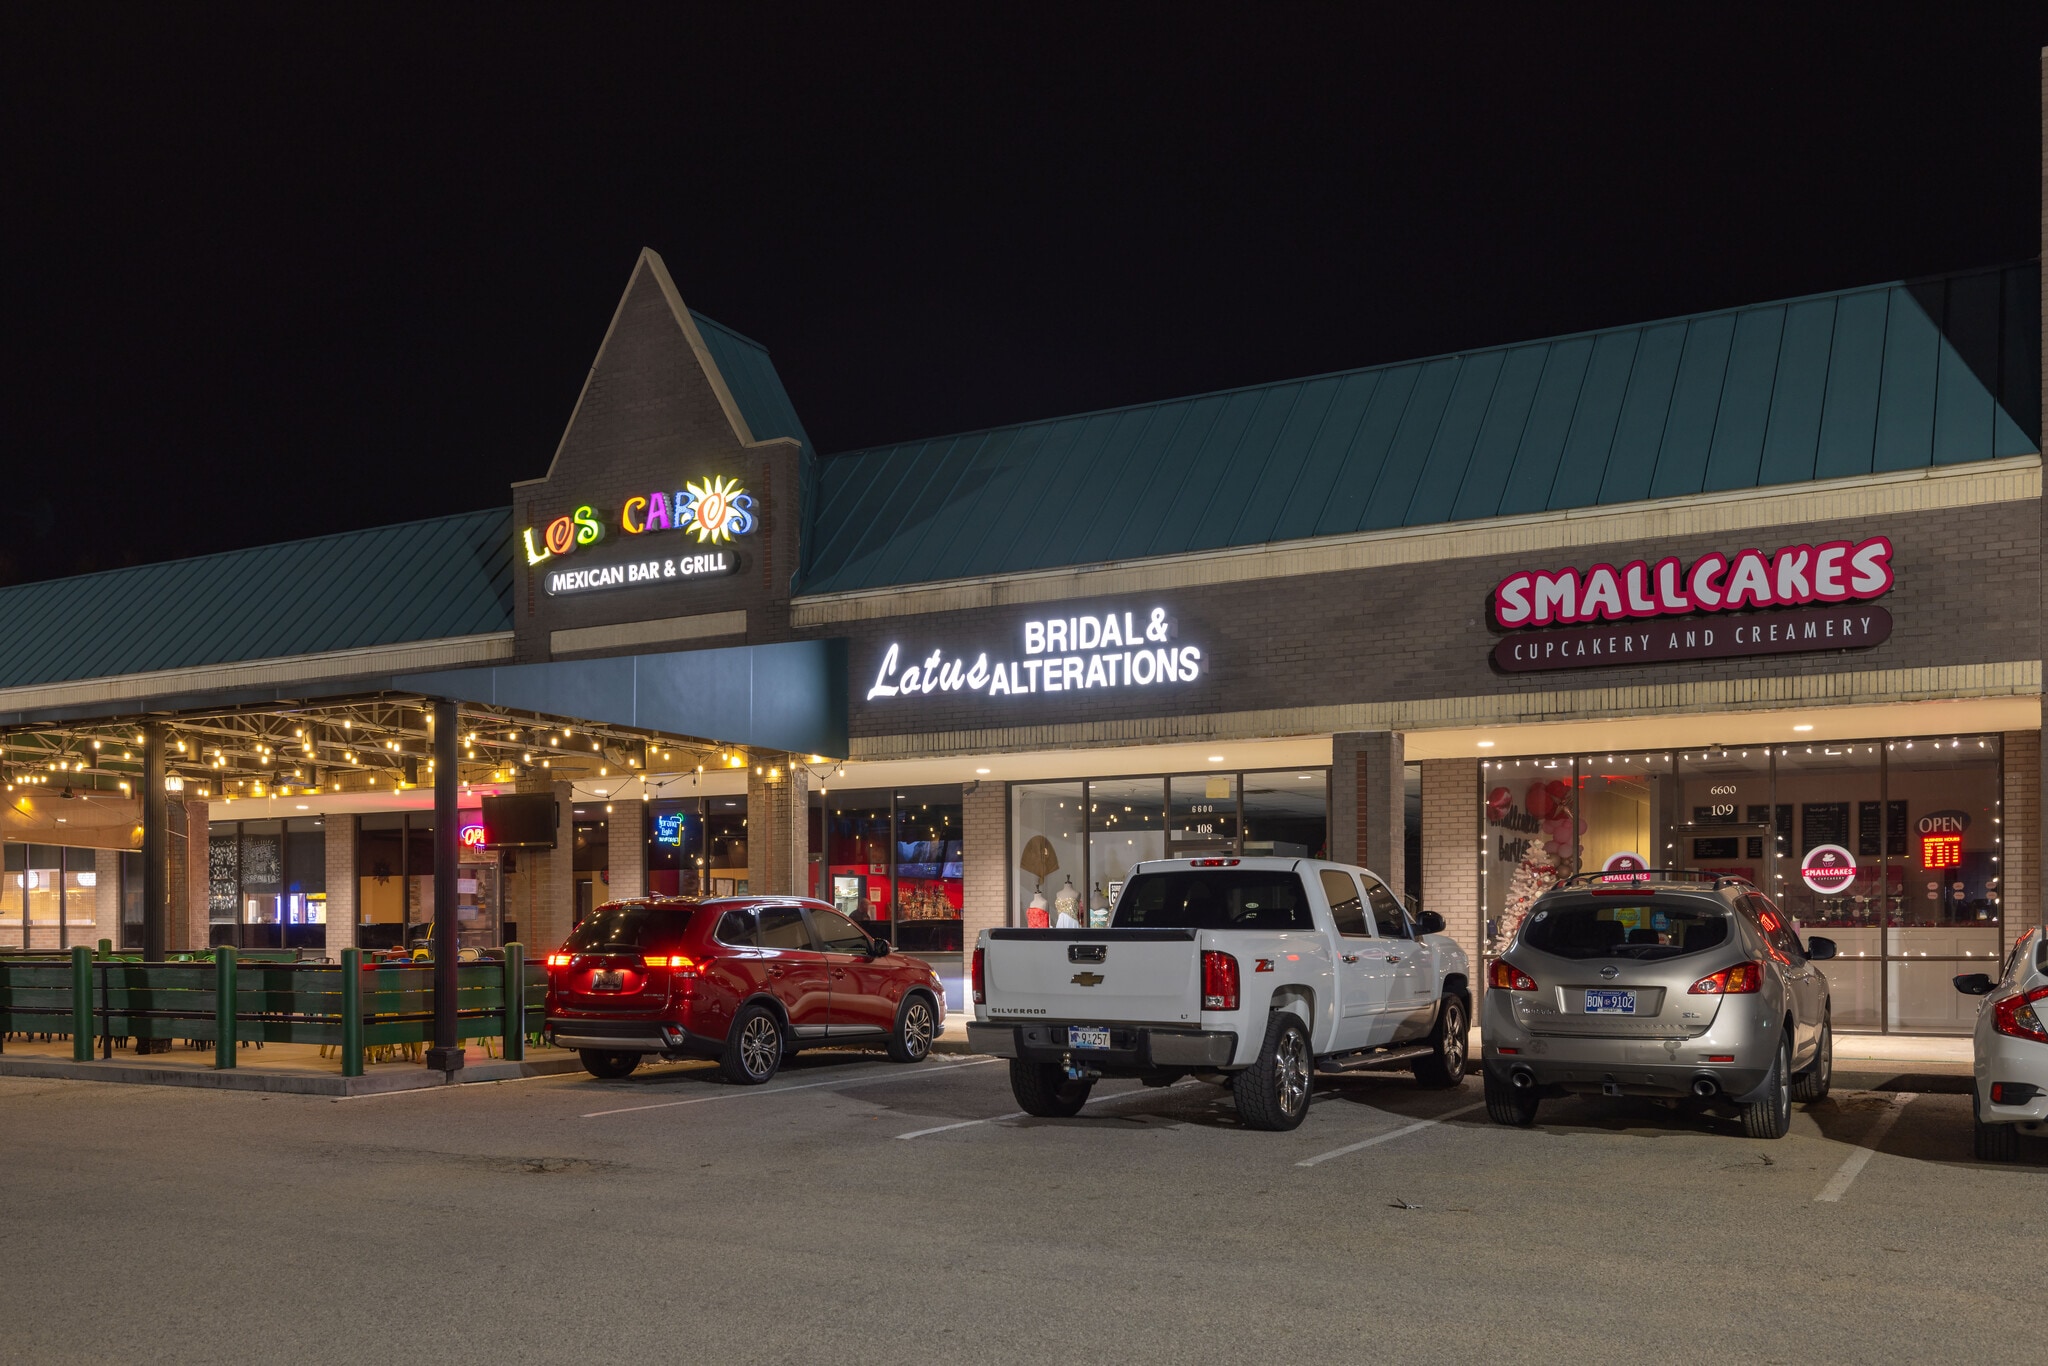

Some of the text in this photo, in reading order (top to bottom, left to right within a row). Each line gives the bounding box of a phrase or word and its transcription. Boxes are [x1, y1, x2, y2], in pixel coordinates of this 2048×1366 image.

[523, 490, 754, 566] LOS CABOS
[551, 552, 727, 592] MEXICAN BAR & GRILL
[1500, 541, 1888, 624] SMALLCAKES
[1025, 606, 1169, 655] BRIDAL &
[1514, 617, 1873, 661] CUPCAKERY AND CREAMERY
[988, 646, 1201, 697] ALTERATIONS
[1710, 785, 1737, 795] 6600
[1191, 804, 1213, 813] 6600
[1711, 803, 1734, 816] 109
[1196, 823, 1213, 834] 108
[1918, 816, 1963, 833] OPEN
[1804, 868, 1853, 876] SMALLCAKES
[1611, 996, 1634, 1008] 9102
[991, 1007, 1047, 1015] SILVERADO
